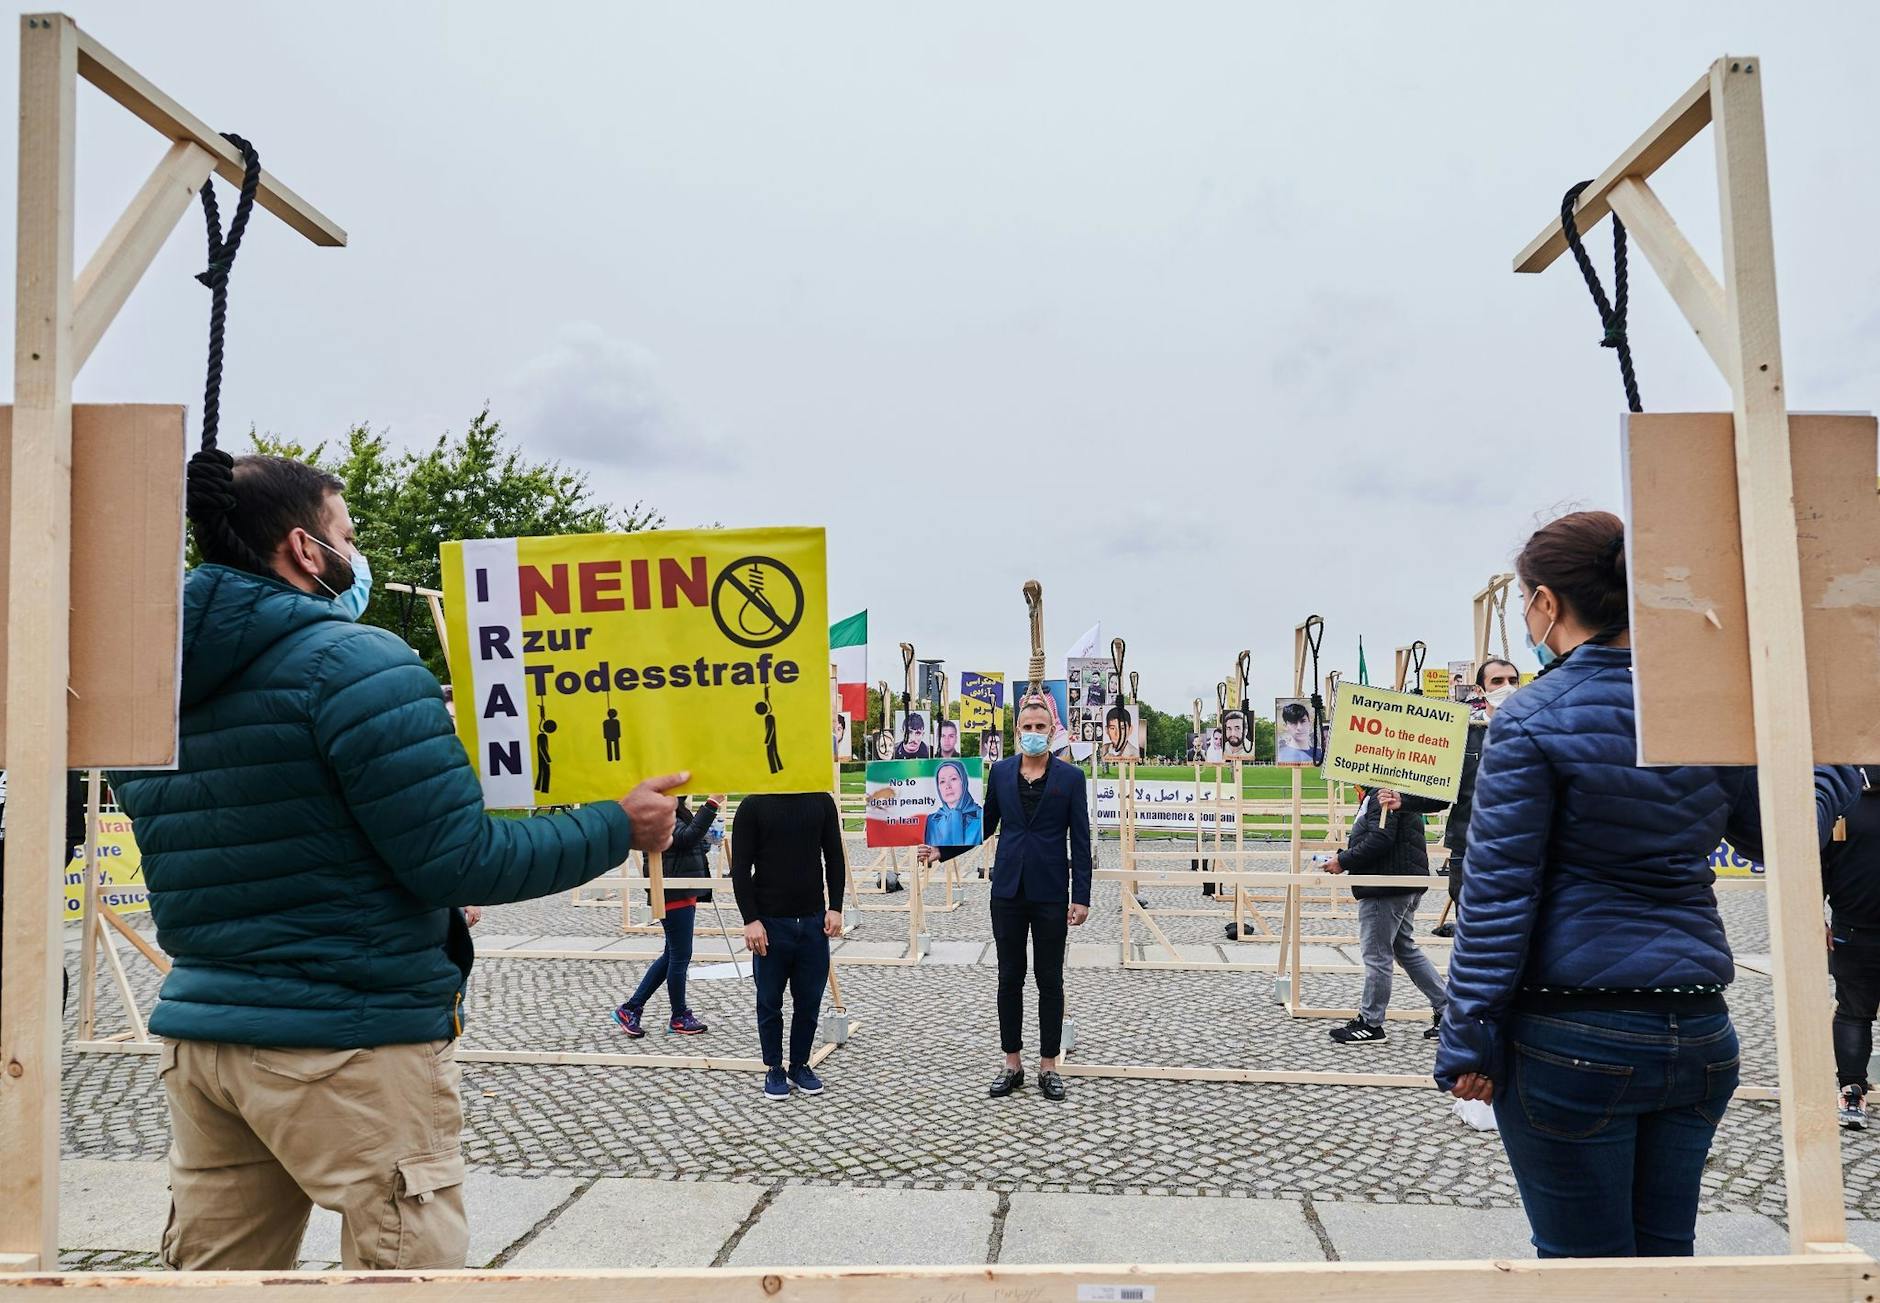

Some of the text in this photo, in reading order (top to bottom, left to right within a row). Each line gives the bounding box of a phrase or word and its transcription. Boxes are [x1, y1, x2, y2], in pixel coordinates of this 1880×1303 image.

[518, 556, 710, 616] NEIN
[523, 627, 593, 653] zur
[475, 568, 523, 776] IRAN
[524, 653, 800, 696] Todesstrafe
[1351, 694, 1454, 723] Maryam RAJAVI:
[1349, 715, 1449, 748] NO to the death
[1355, 743, 1437, 766] penalty in IRAN
[906, 778, 916, 786] to
[1334, 757, 1369, 773] Stoppt
[1372, 763, 1451, 787] Hinrichtungen!
[870, 796, 936, 807] death penalty
